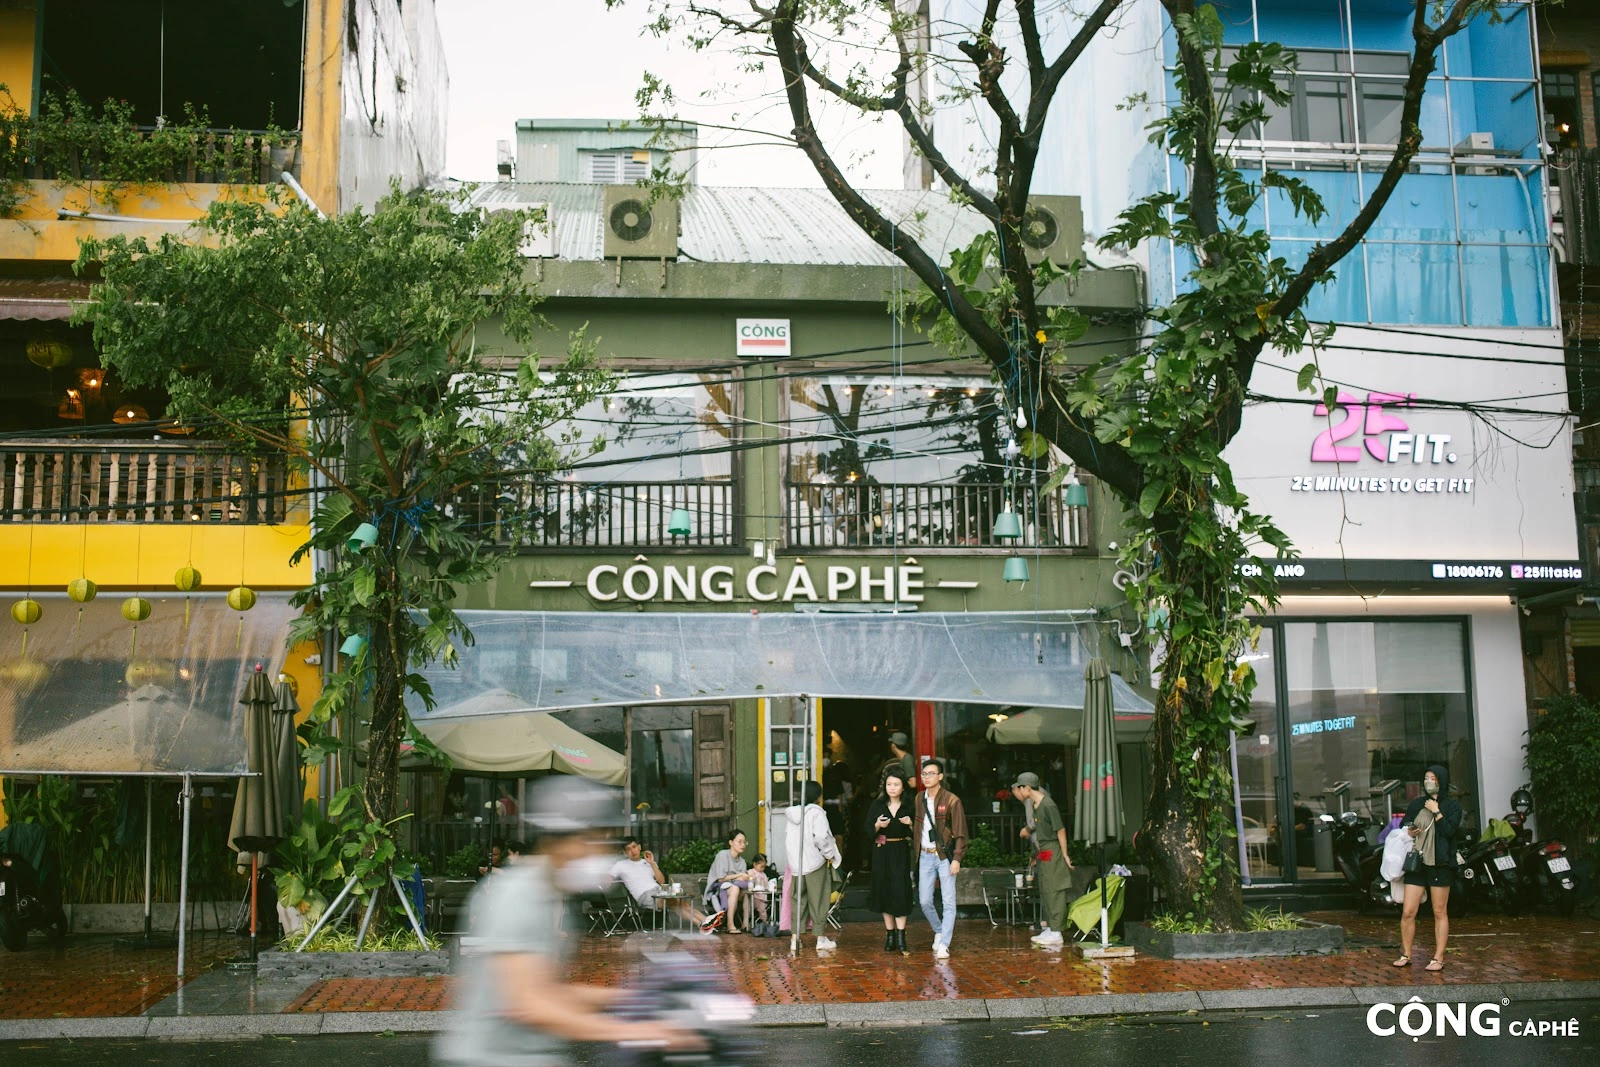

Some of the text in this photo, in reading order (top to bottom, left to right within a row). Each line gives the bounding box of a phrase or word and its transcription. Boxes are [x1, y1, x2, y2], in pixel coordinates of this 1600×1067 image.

[1291, 476, 1473, 493] 25 MINUTES TO GET FIT
[586, 554, 734, 602] CÔNG
[1446, 565, 1504, 578] 18006176
[1523, 566, 1582, 579] 25fitasia
